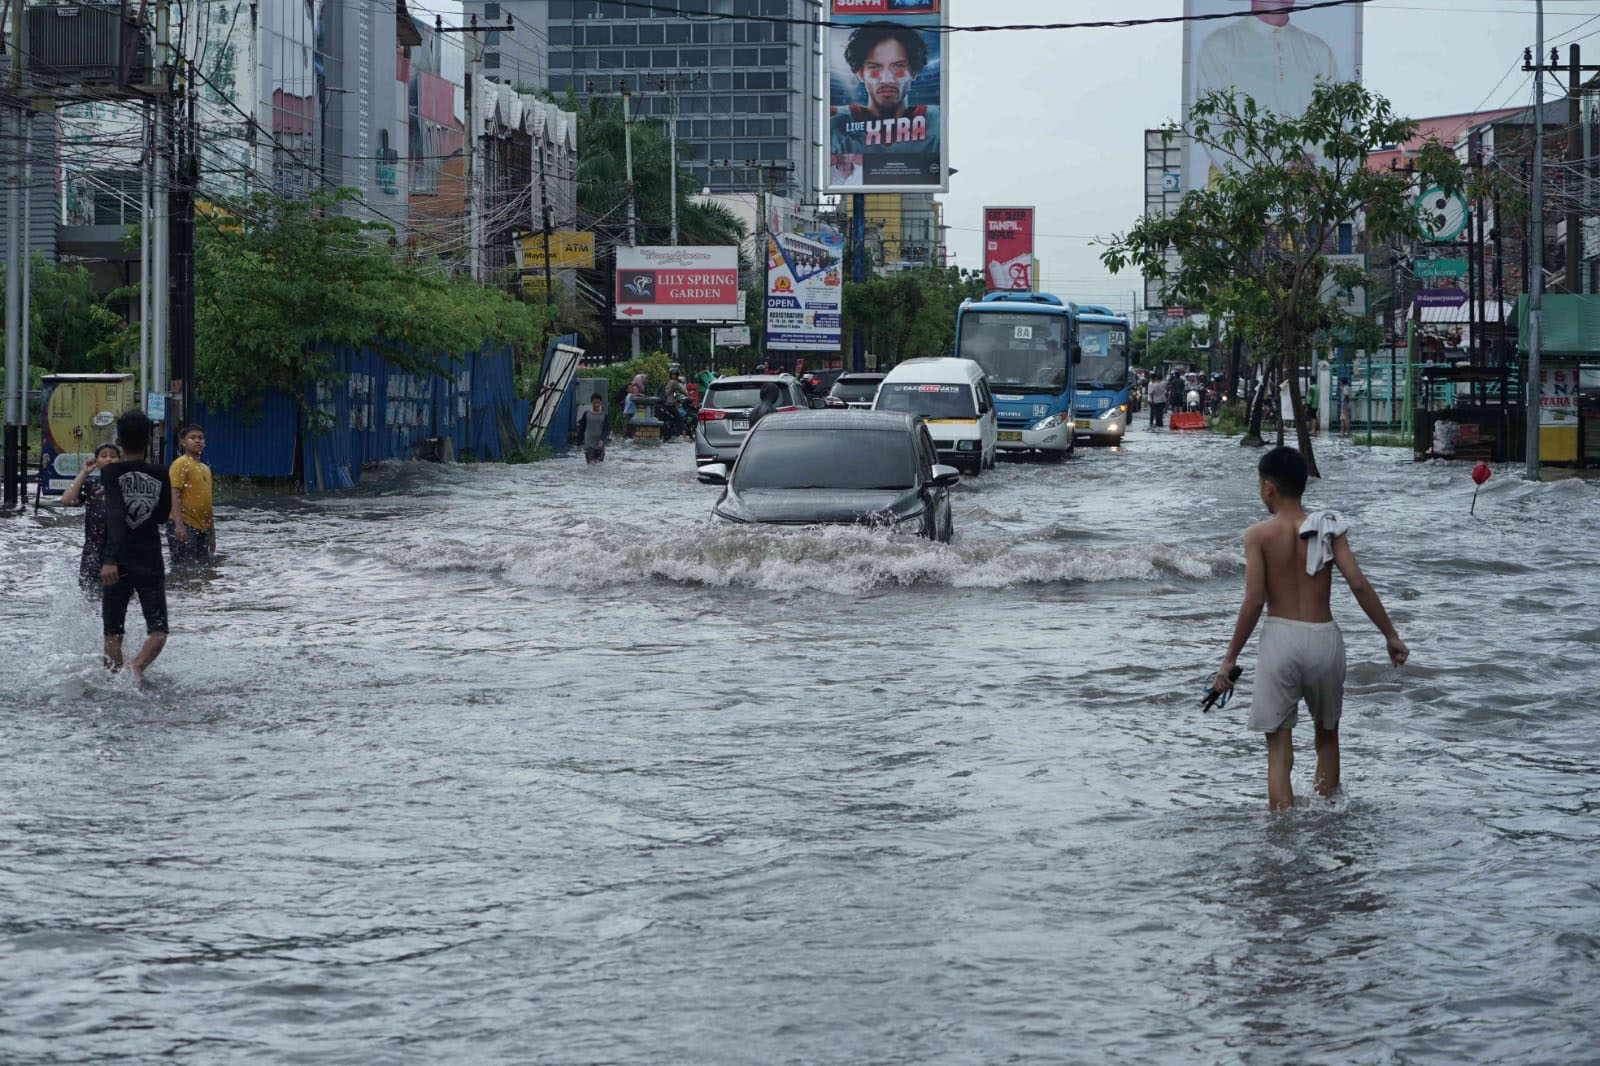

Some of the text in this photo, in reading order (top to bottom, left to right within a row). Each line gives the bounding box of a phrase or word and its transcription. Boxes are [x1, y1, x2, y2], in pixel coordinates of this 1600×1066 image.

[846, 115, 926, 146] LIVE XTRA
[988, 220, 1023, 231] TAMPIL,
[565, 243, 589, 252] ATM
[658, 274, 735, 286] LILY SPRING
[670, 288, 721, 299] GARDEN
[767, 298, 794, 308] OPEN
[1016, 327, 1031, 338] 8A
[1109, 332, 1124, 344] 8A
[1034, 405, 1045, 416] 94
